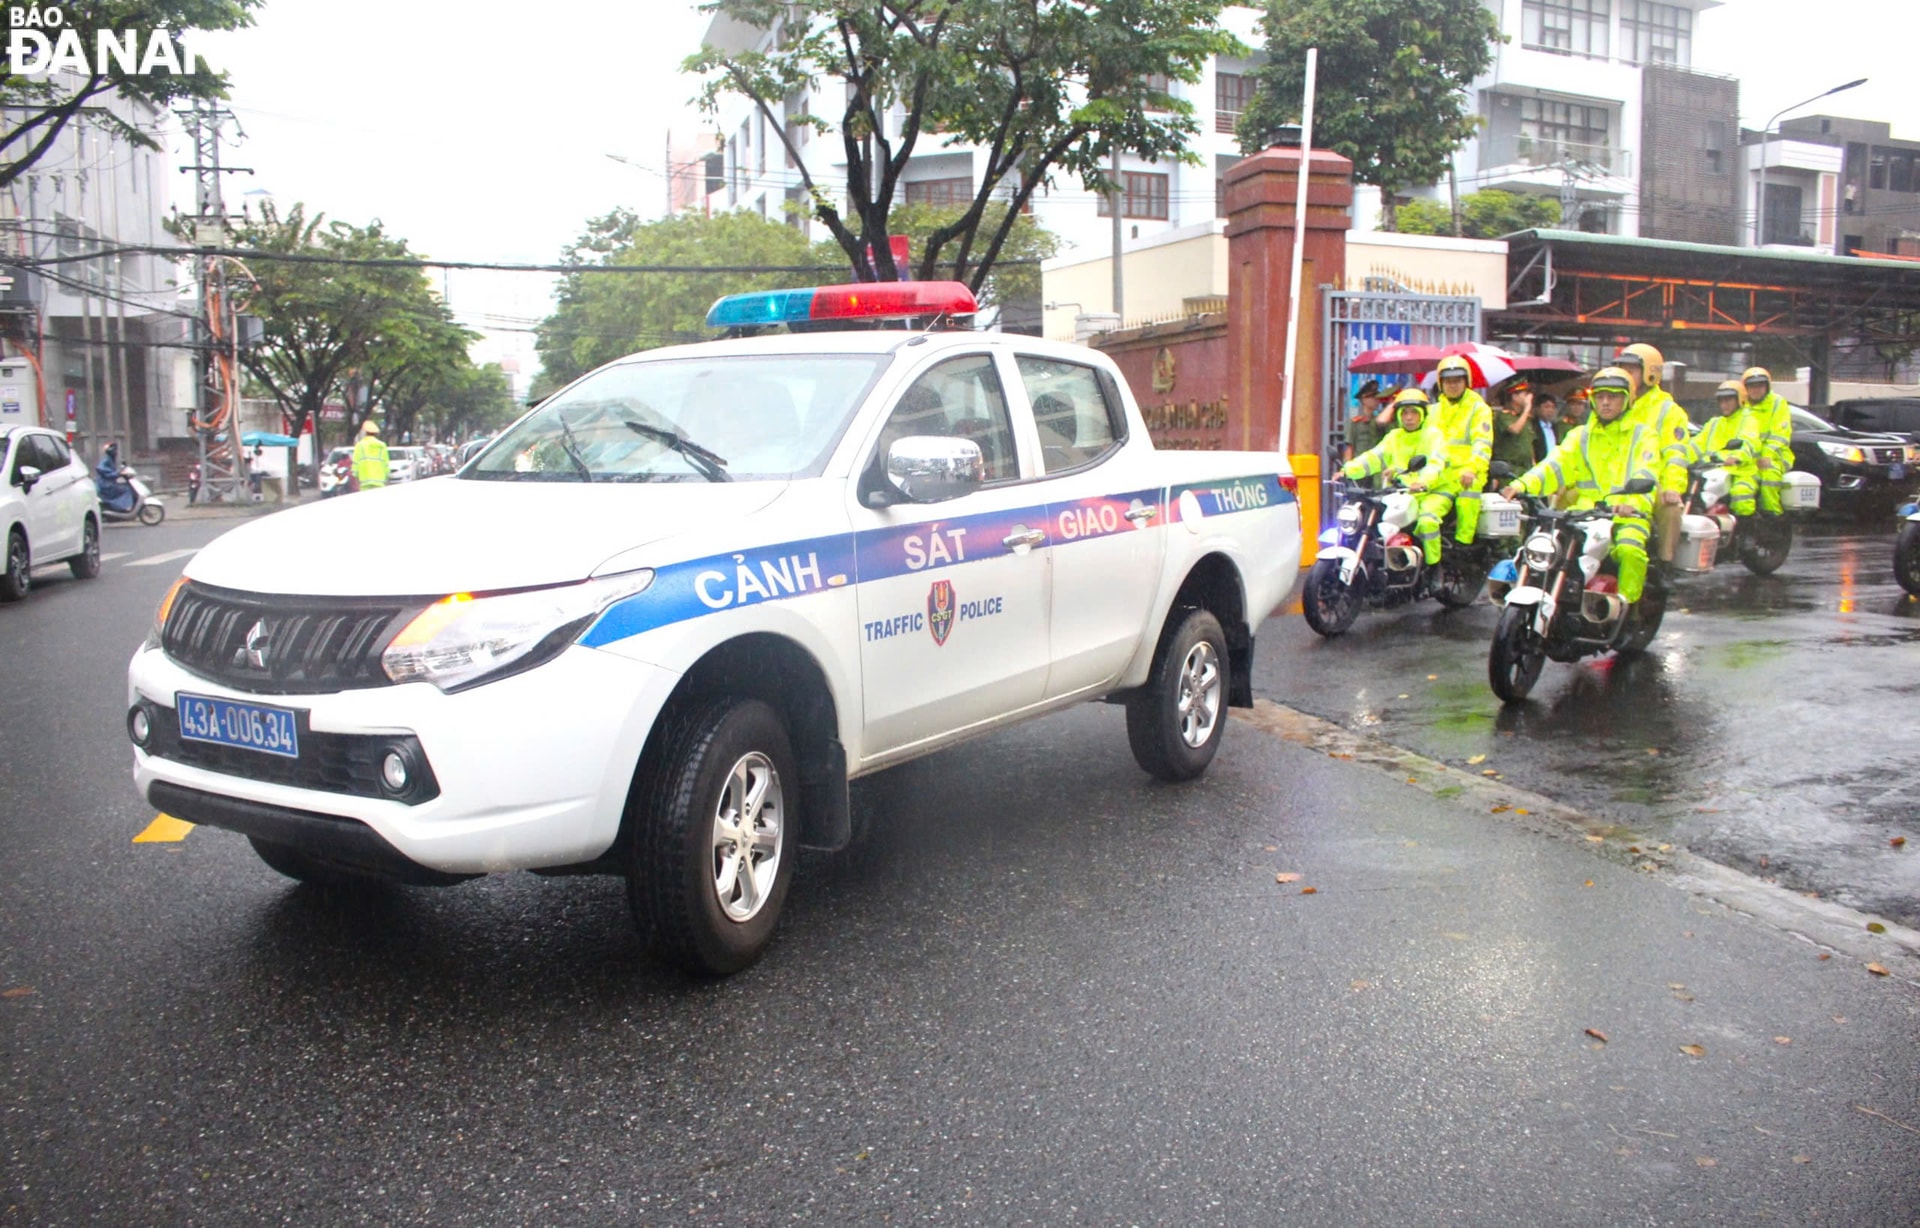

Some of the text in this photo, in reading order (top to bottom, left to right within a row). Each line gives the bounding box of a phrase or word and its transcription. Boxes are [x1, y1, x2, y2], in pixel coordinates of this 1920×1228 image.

[694, 480, 1267, 609] CẢNH SÁT GIAO THÔNG
[864, 597, 1003, 642] TRAFFIC POLICE
[184, 700, 292, 751] 43A-006.34
